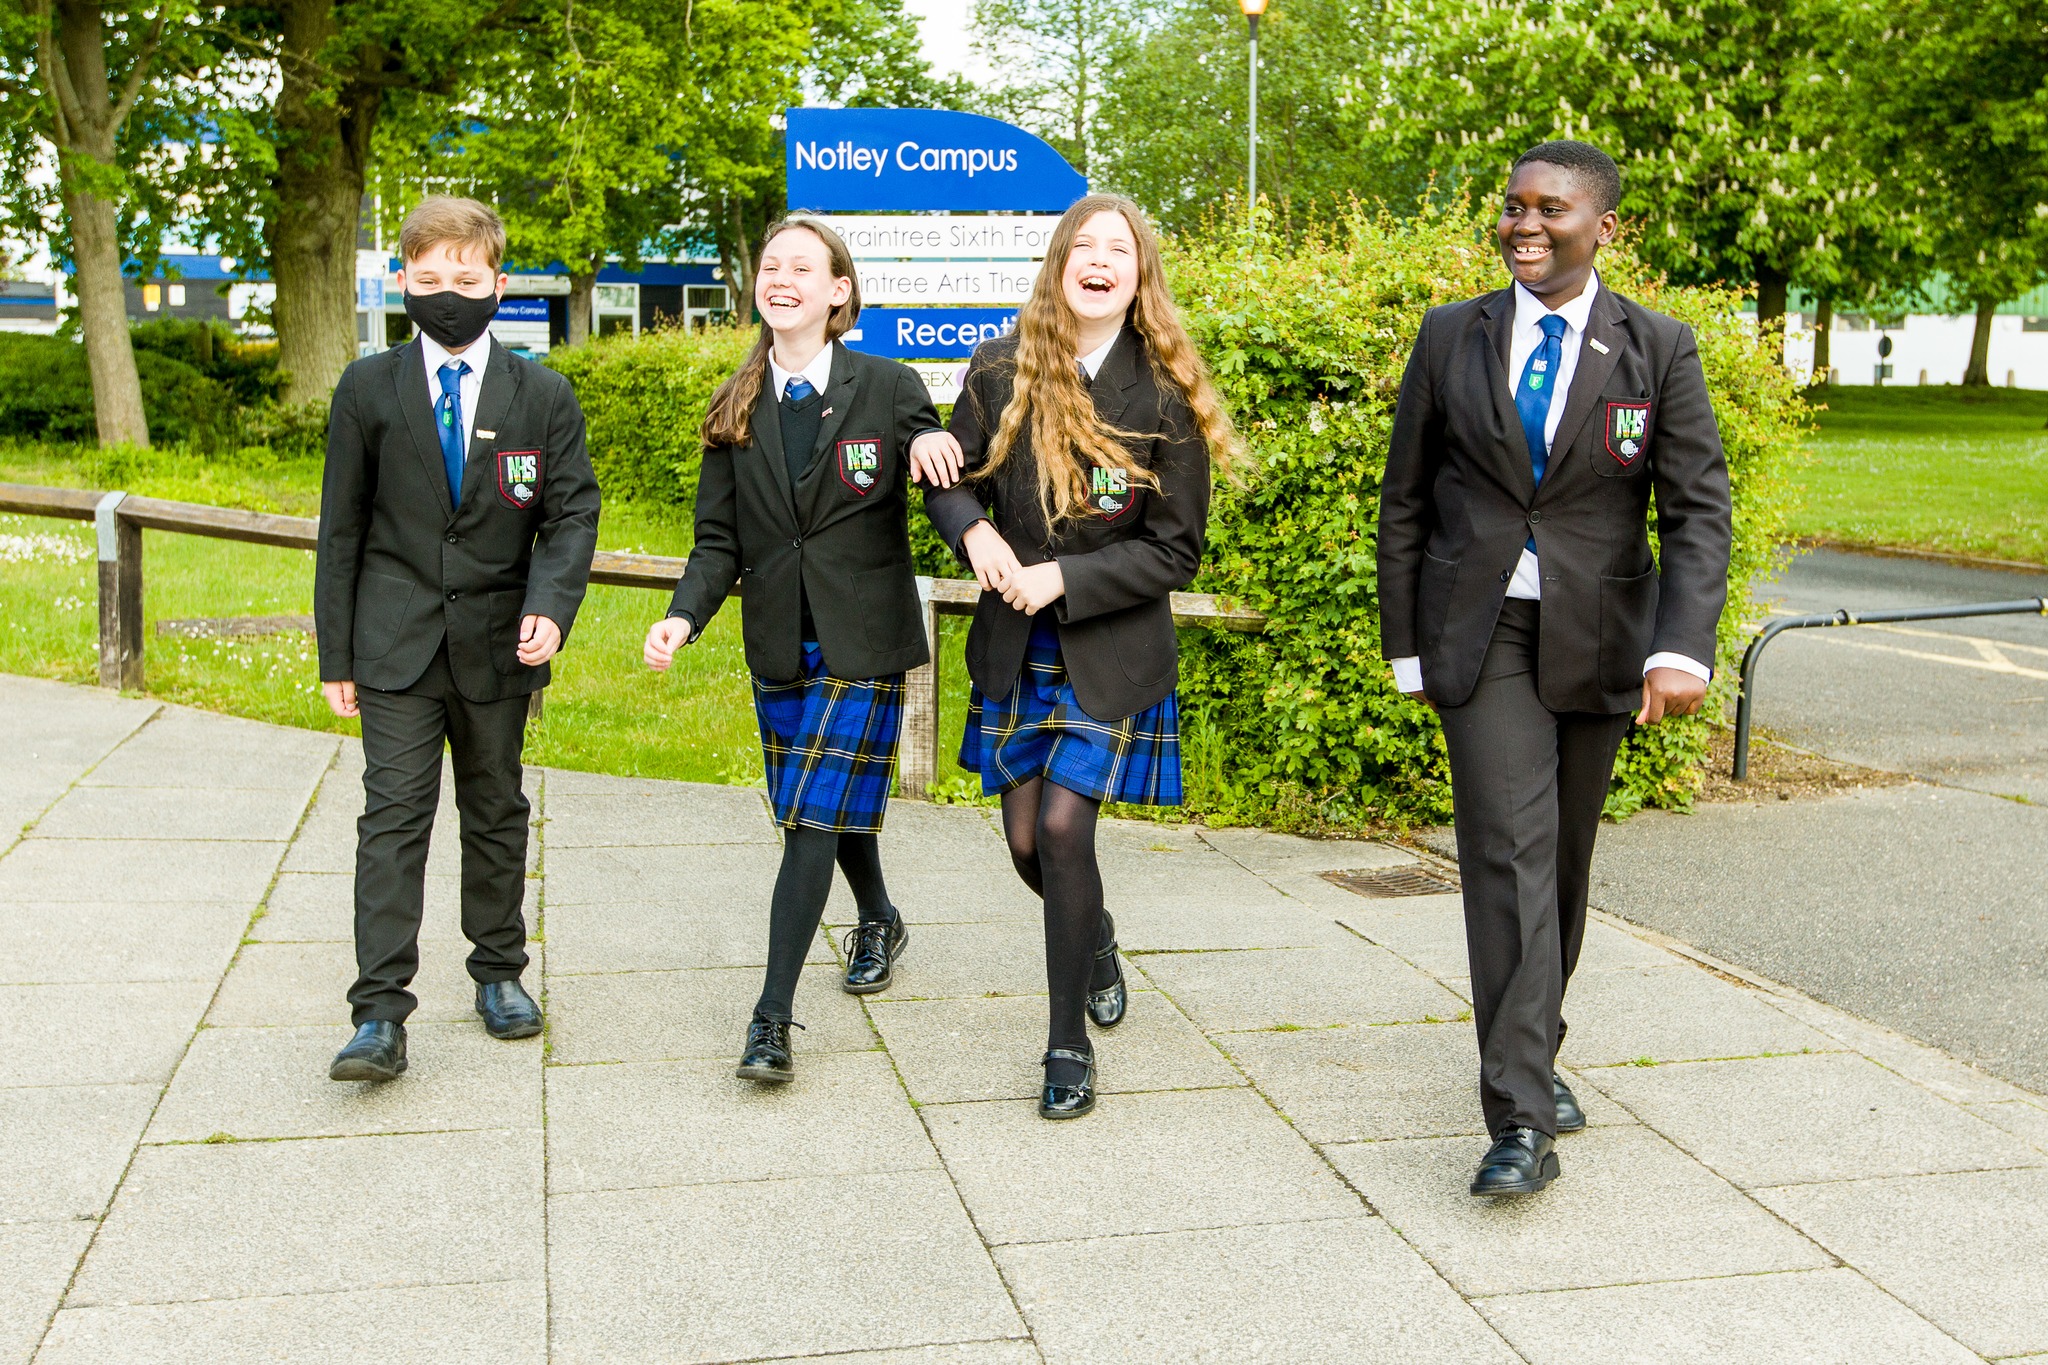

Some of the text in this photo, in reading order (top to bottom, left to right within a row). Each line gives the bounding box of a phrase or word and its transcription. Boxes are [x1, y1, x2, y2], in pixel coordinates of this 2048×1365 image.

[795, 141, 1018, 178] Notley Campus
[950, 225, 1004, 247] Sixth
[1014, 225, 1050, 247] For
[860, 271, 928, 293] intree
[937, 272, 980, 293] Arts
[897, 317, 1018, 345] Recept
[1532, 358, 1548, 372] NHS
[920, 371, 953, 387] SEX
[1532, 375, 1542, 387] F
[1615, 408, 1647, 439] NHS
[506, 455, 537, 484] NHS
[845, 443, 877, 471] NHS
